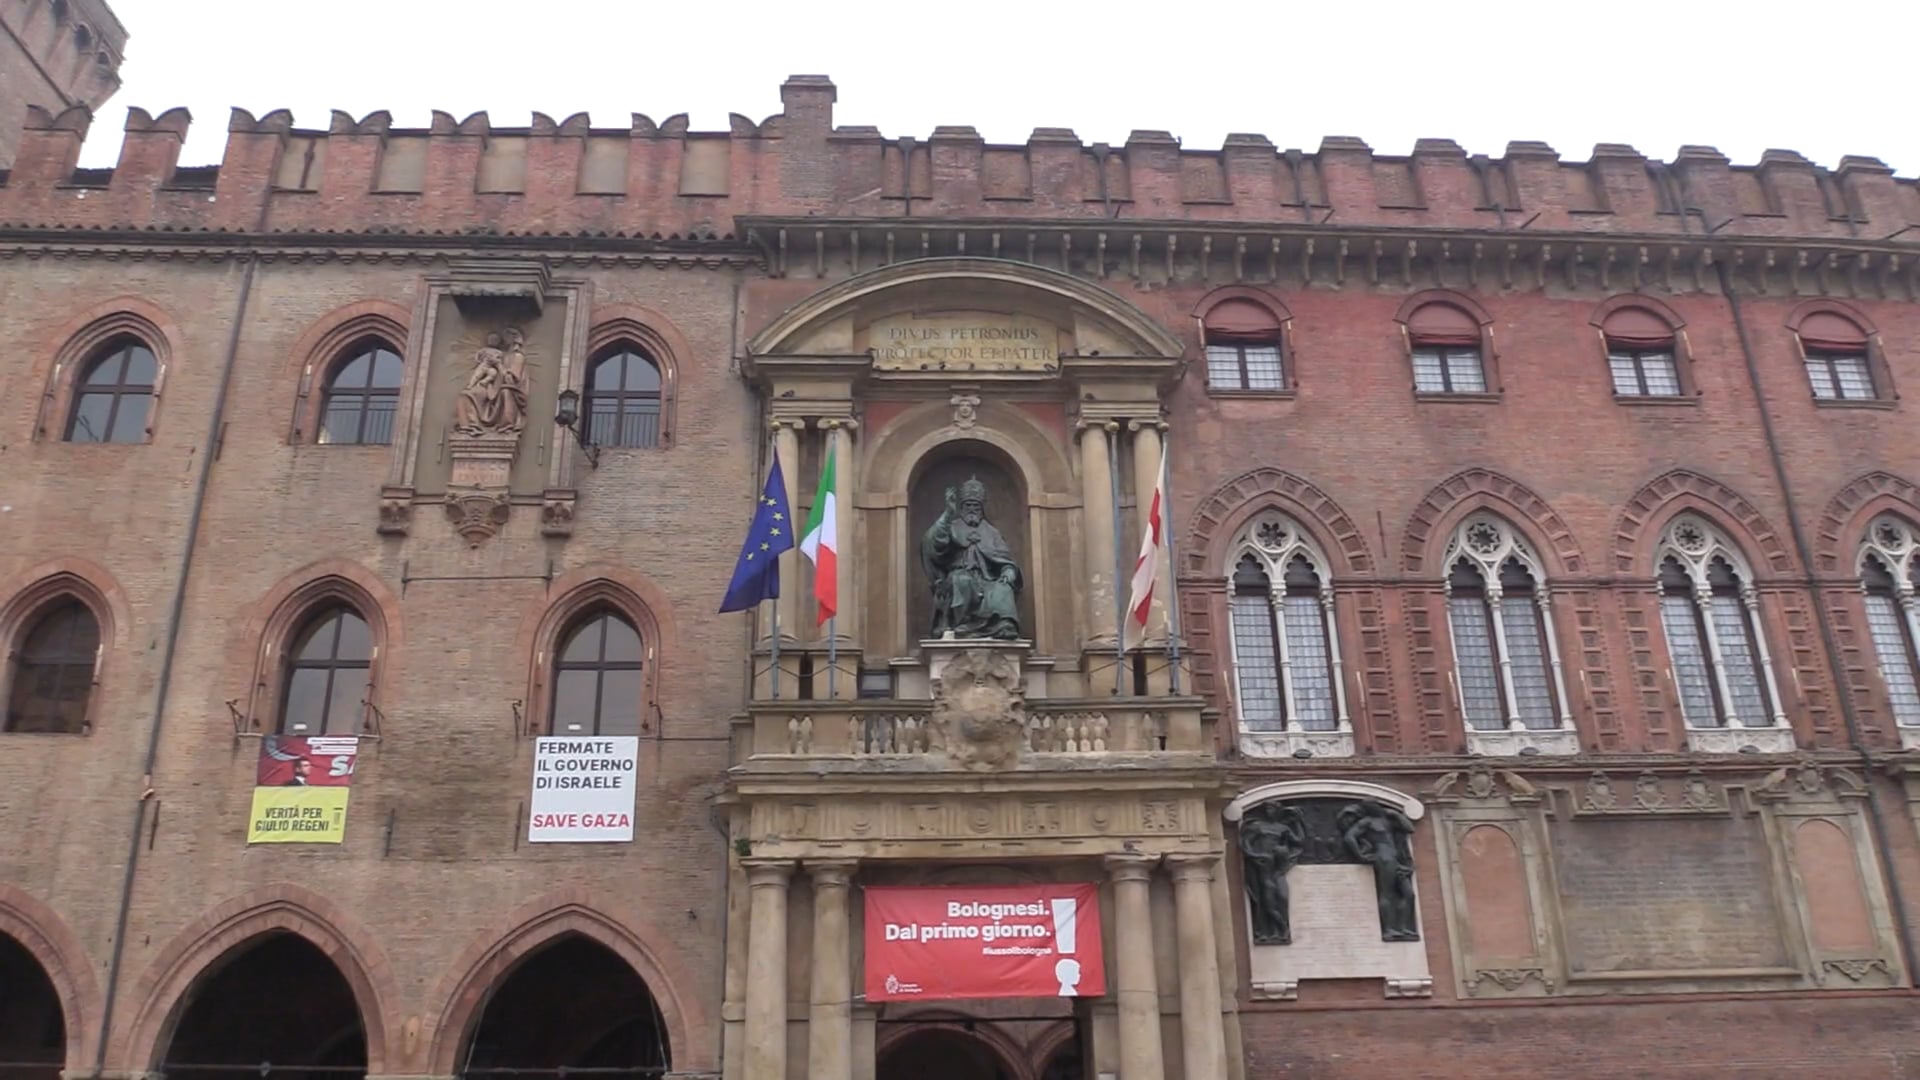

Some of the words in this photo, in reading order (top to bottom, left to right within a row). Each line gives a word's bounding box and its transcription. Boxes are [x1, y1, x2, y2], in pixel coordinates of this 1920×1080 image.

[951, 327, 1039, 340] PETRONIUS
[539, 742, 613, 754] FERMATE
[538, 759, 550, 771] IL
[555, 759, 633, 771] GOVERNO
[536, 777, 552, 789] DI
[556, 777, 622, 789] ISRAELE
[265, 805, 299, 818] VERITÀ
[302, 807, 322, 818] PER
[255, 820, 289, 832] GIULIO
[291, 820, 329, 831] REGENI
[533, 814, 577, 828] SAVE
[582, 814, 629, 828] GAZA
[947, 899, 1050, 919] Bolognesi.
[885, 923, 917, 941] Dal
[921, 921, 979, 943] primo
[982, 921, 1051, 942] giorno.
